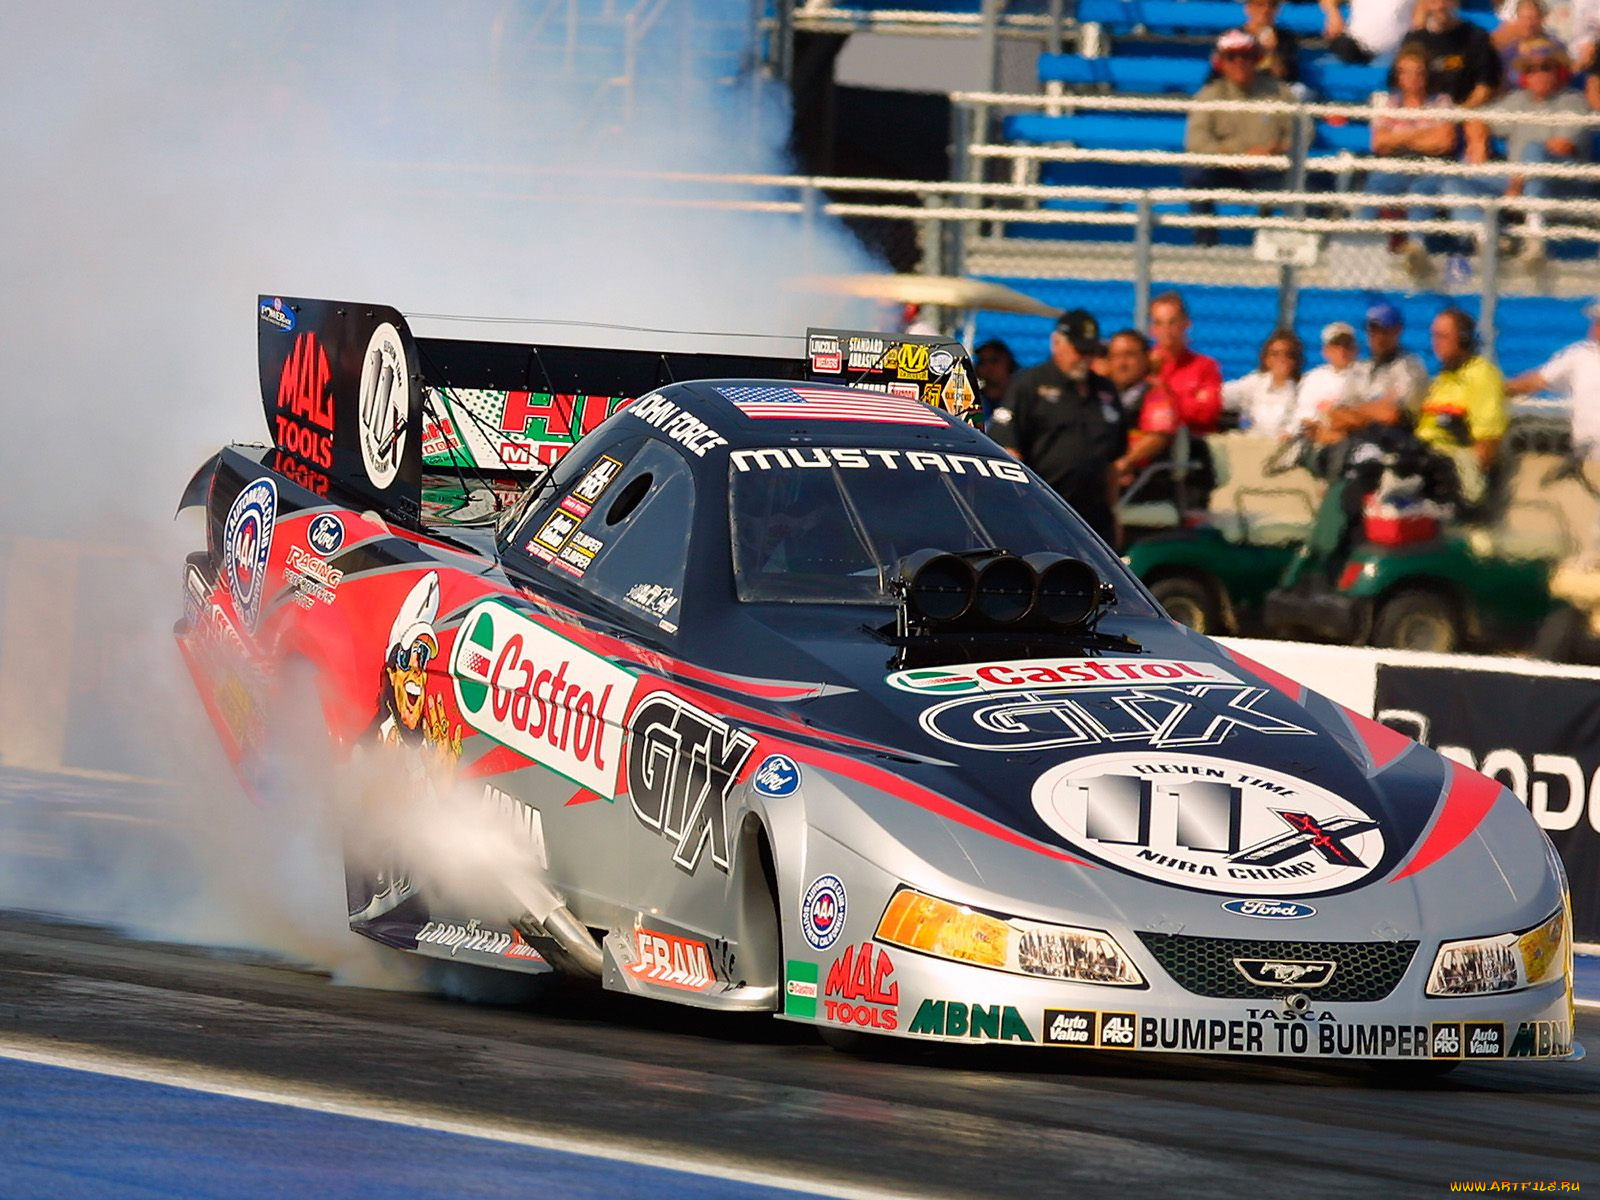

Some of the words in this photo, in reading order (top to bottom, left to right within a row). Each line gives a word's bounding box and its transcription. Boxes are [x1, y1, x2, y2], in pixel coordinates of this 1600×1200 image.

[849, 337, 884, 353] STANDARD
[276, 331, 336, 431] MAC
[275, 415, 335, 469] TOOLS
[628, 394, 672, 432] JOHN
[663, 406, 728, 458] FORCE
[729, 448, 1030, 485] MUSTANG
[575, 475, 605, 500] PRO
[260, 508, 272, 547] CLUB
[311, 517, 339, 550] Ford
[572, 531, 604, 554] BUMPER
[235, 531, 256, 571] AAA
[285, 544, 343, 589] RACING
[559, 547, 592, 570] BUMPER
[975, 660, 1219, 685] Castrol
[490, 633, 614, 771] Castrol
[918, 685, 1318, 751] GTX
[626, 689, 760, 877] GTX
[756, 759, 793, 792] Ford
[1132, 764, 1226, 778] ELEVEN
[1237, 774, 1300, 799] TIME
[1136, 848, 1219, 877] NHRA
[1228, 861, 1316, 881] CHAMP
[813, 901, 834, 919] AAA
[1240, 900, 1299, 918] Ford
[636, 932, 714, 987] FRAM
[824, 941, 899, 1006] MAC
[823, 1000, 898, 1031] TOOLS
[907, 998, 1038, 1043] MBNA
[1052, 1013, 1088, 1029] Auto
[1105, 1017, 1134, 1032] ALL
[1246, 1008, 1337, 1022] TASCA
[1050, 1027, 1089, 1042] Value
[1102, 1030, 1134, 1043] PRO
[1141, 1017, 1263, 1052] BUMPER
[1274, 1022, 1308, 1053] TO
[1318, 1023, 1429, 1057] BUMPER
[1434, 1040, 1459, 1053] PRO
[1437, 1028, 1459, 1042] ALL
[1469, 1040, 1500, 1054] Value
[1471, 1027, 1499, 1042] Auto
